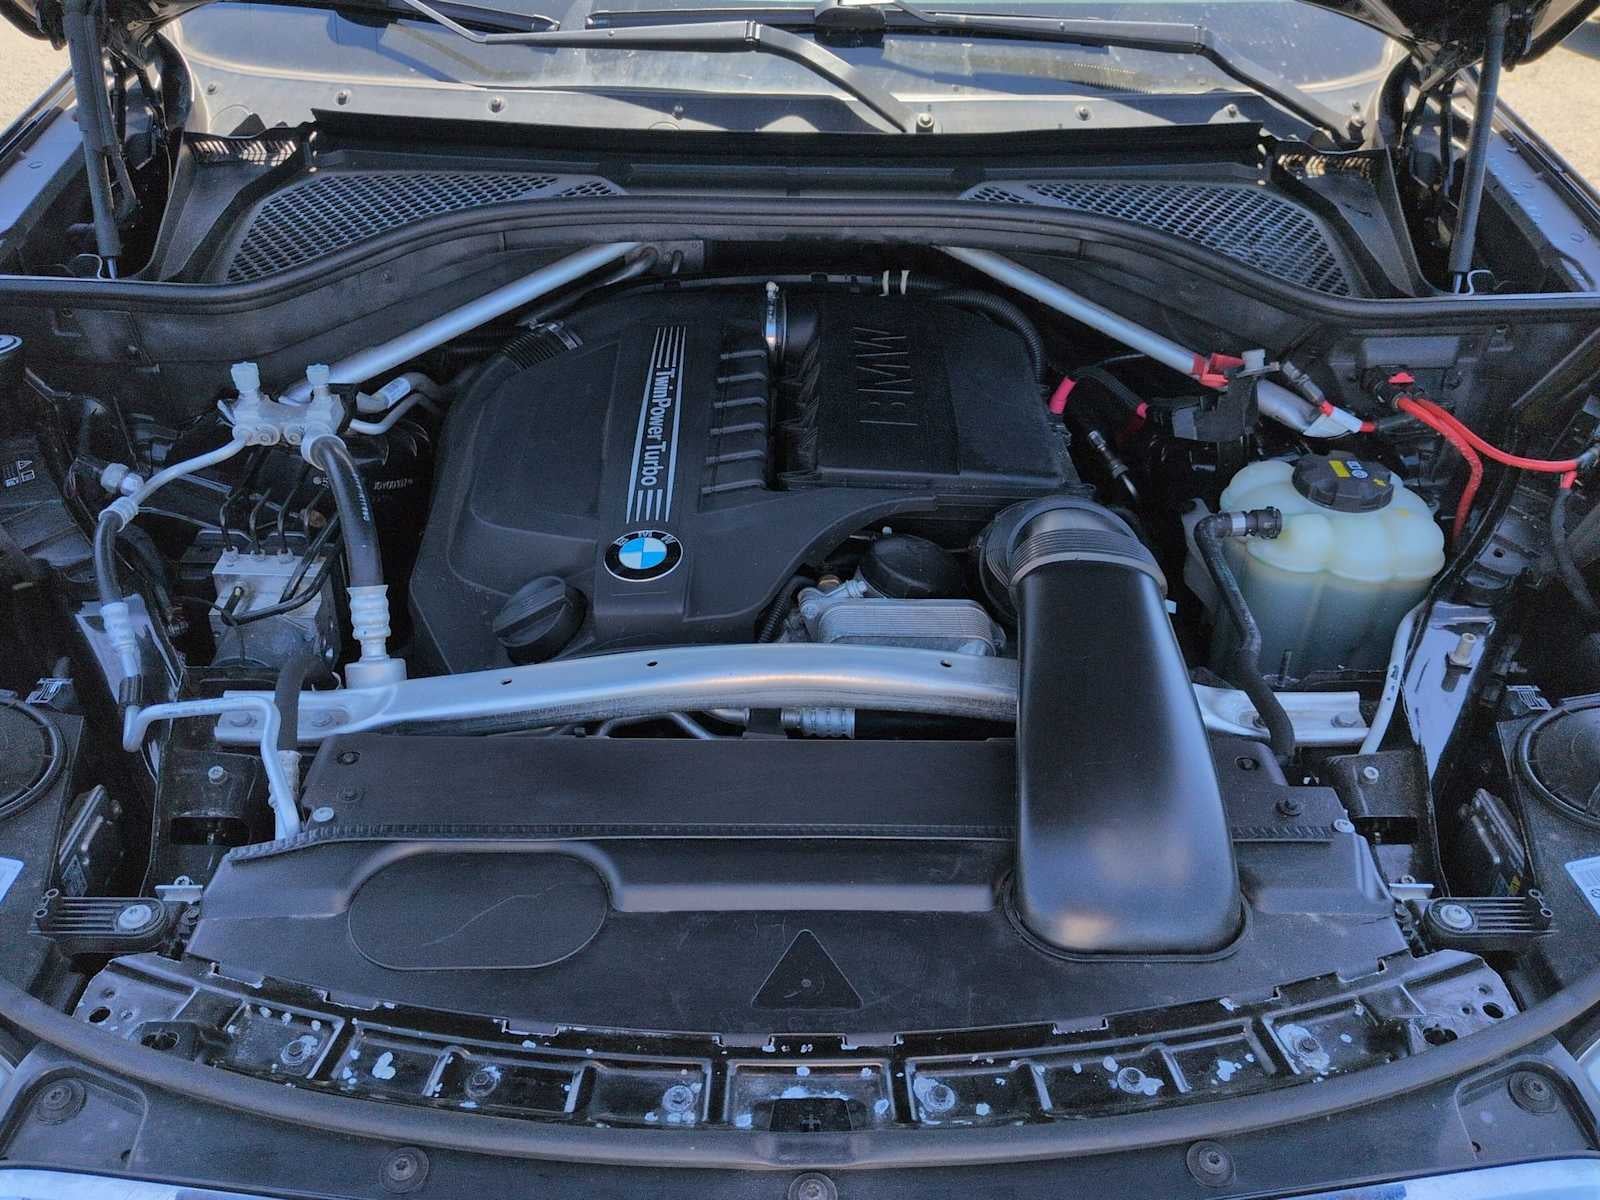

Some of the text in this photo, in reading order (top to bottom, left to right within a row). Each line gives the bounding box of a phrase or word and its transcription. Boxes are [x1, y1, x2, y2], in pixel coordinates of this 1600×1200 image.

[640, 367, 676, 487] TwinPower Turbo
[852, 326, 919, 426] BMW
